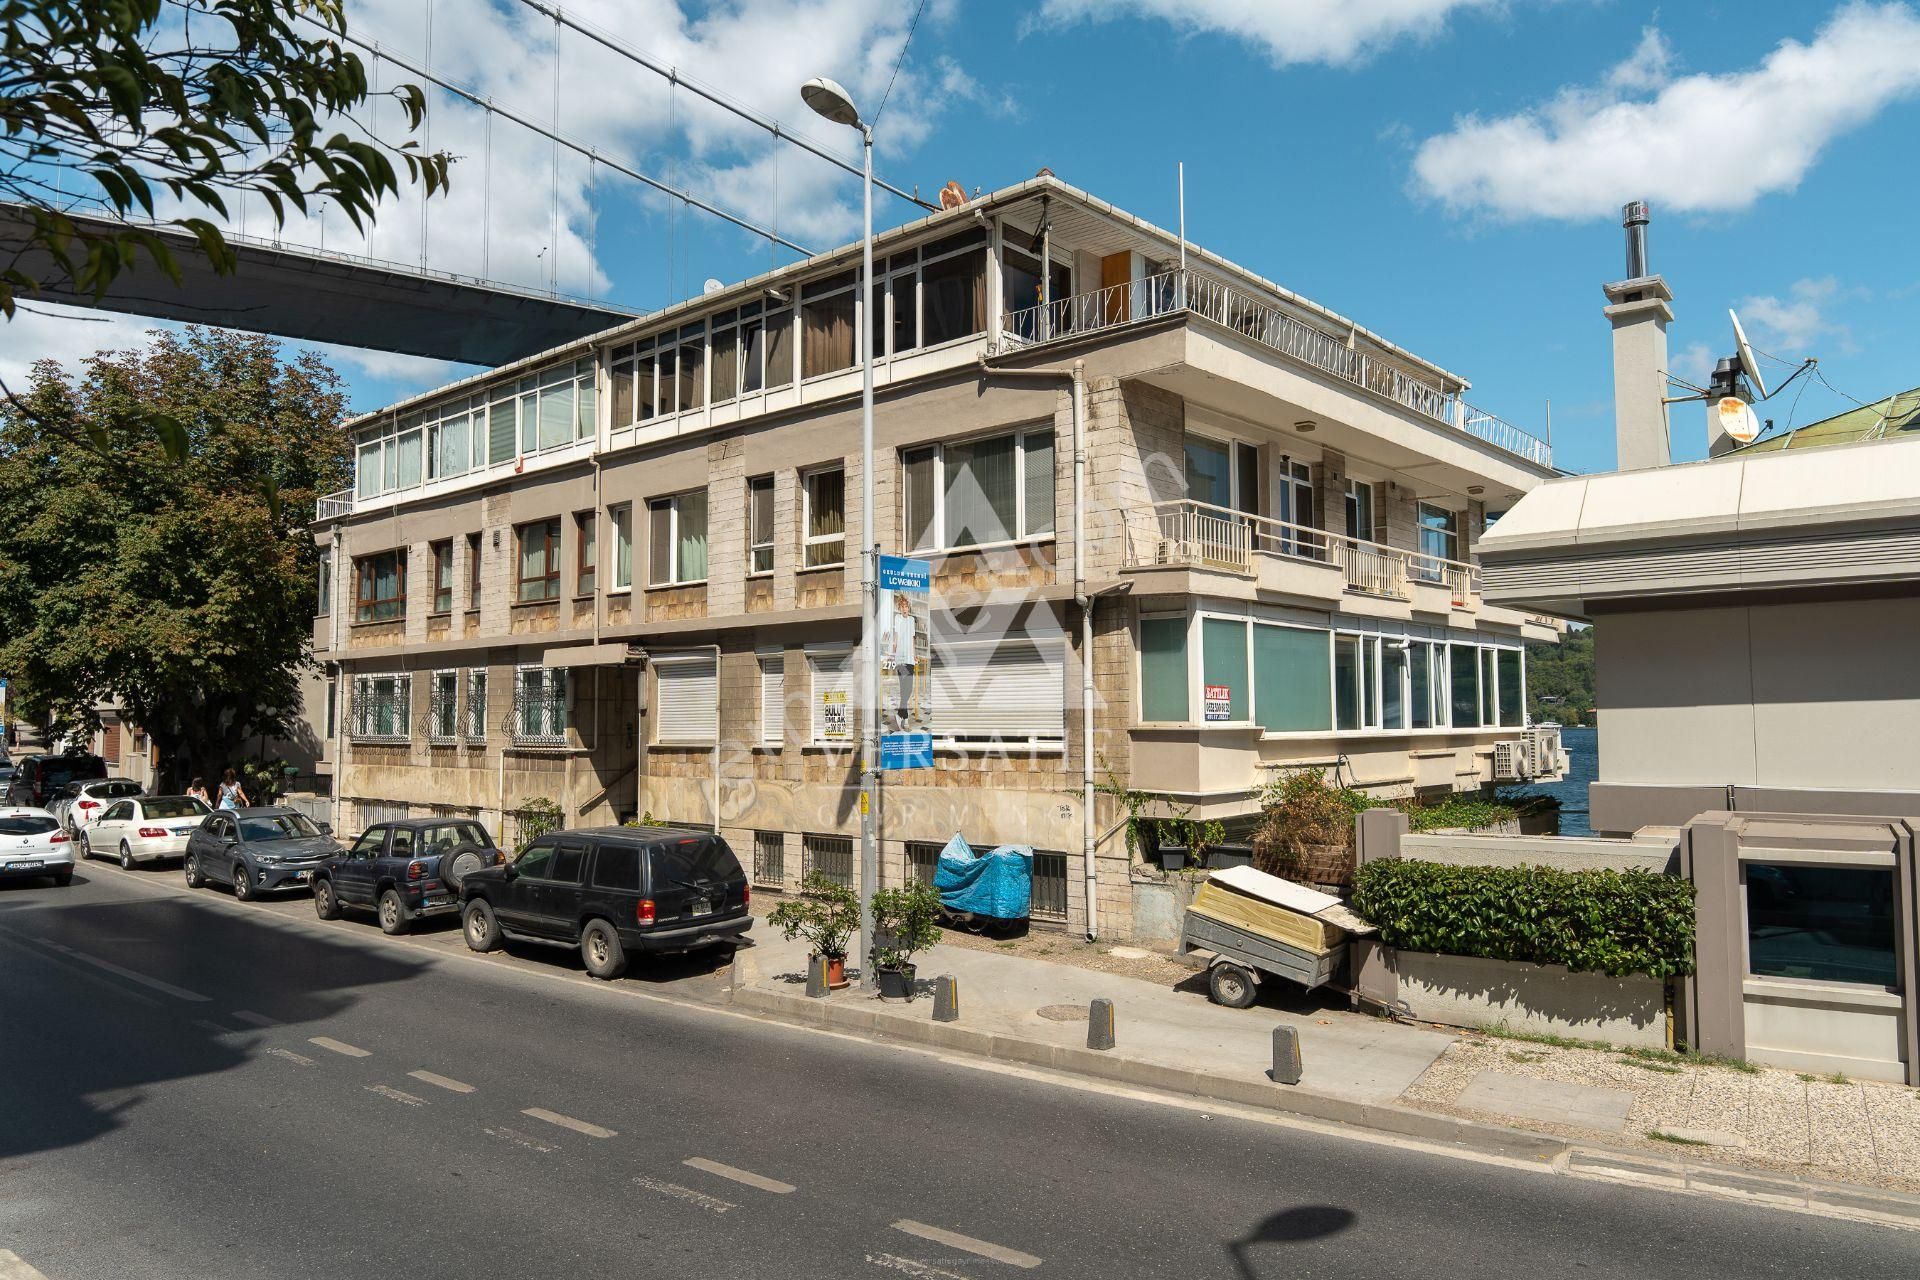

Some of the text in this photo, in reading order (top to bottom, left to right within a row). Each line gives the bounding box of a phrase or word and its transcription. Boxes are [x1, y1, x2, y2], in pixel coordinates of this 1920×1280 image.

[882, 661, 897, 670] 279
[825, 704, 846, 717] BULUT
[825, 716, 846, 724] EMLAK
